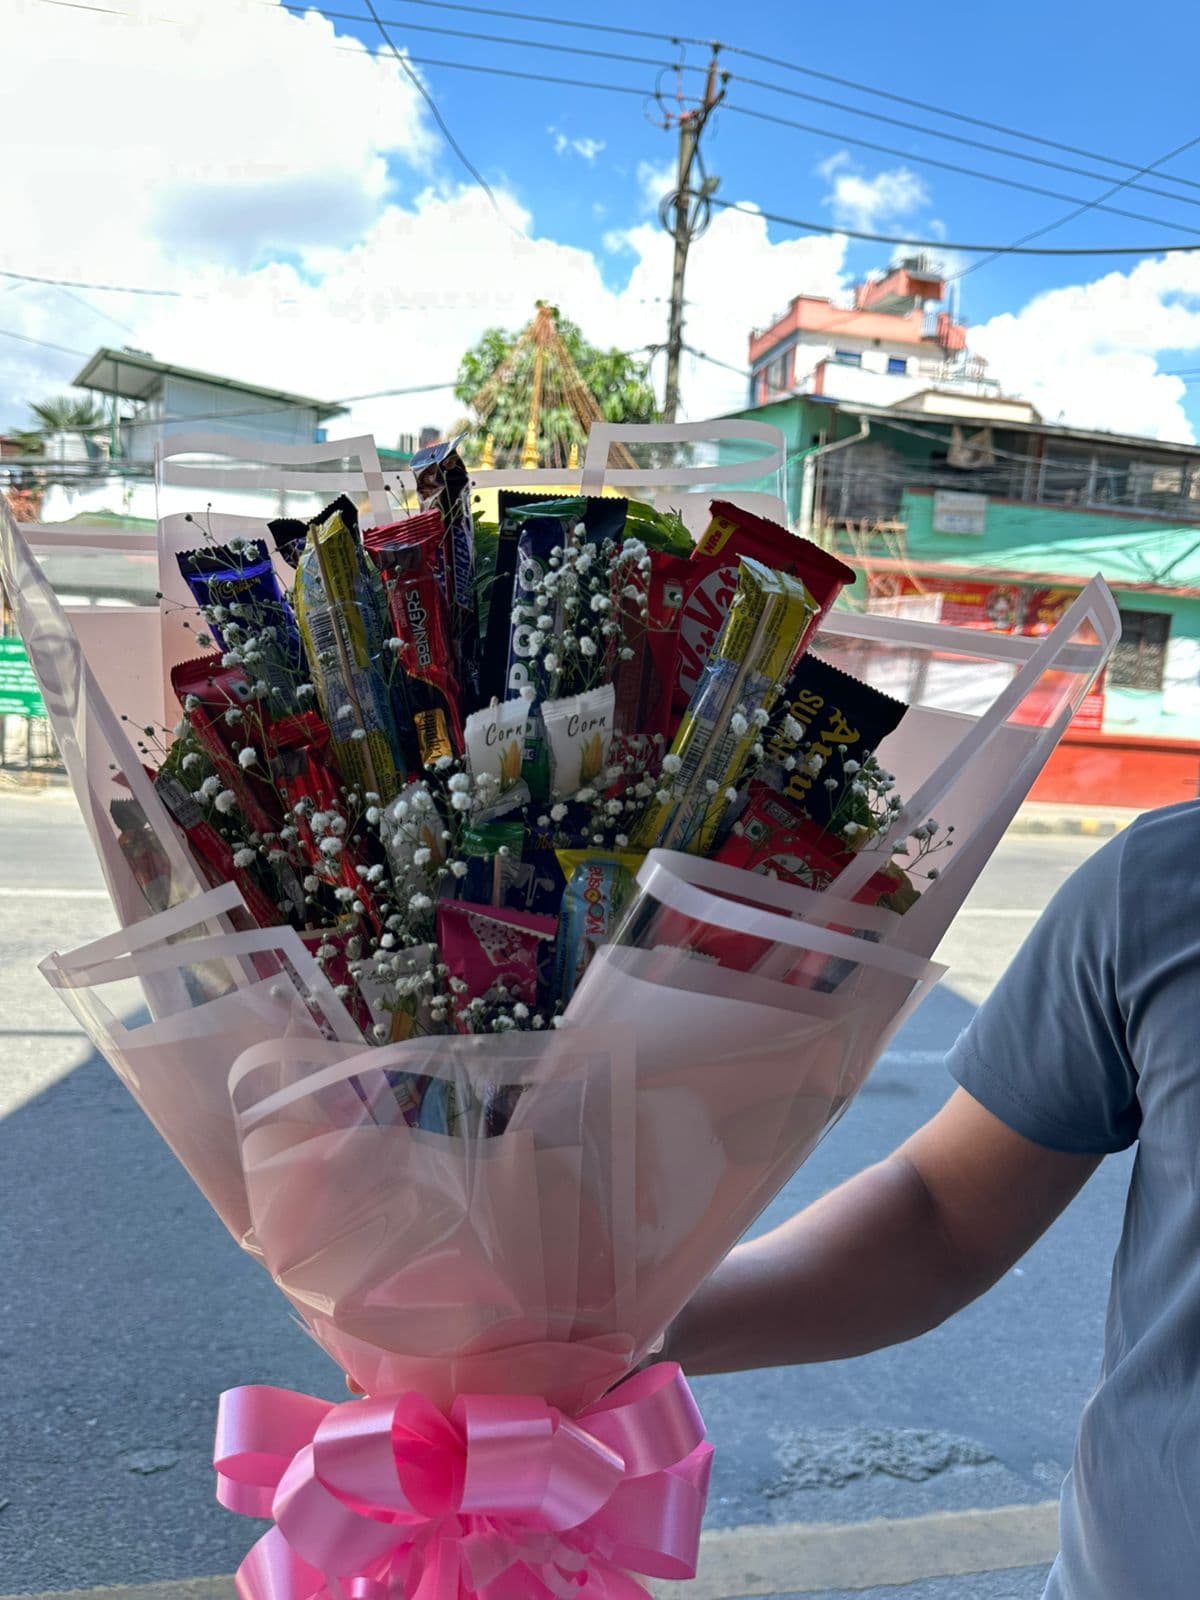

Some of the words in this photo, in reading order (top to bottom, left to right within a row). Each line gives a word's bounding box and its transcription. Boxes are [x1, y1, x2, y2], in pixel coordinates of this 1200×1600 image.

[405, 588, 432, 667] BONKERS
[486, 723, 522, 746] Corn
[567, 714, 606, 738] Corn
[767, 688, 825, 763] SUAR
